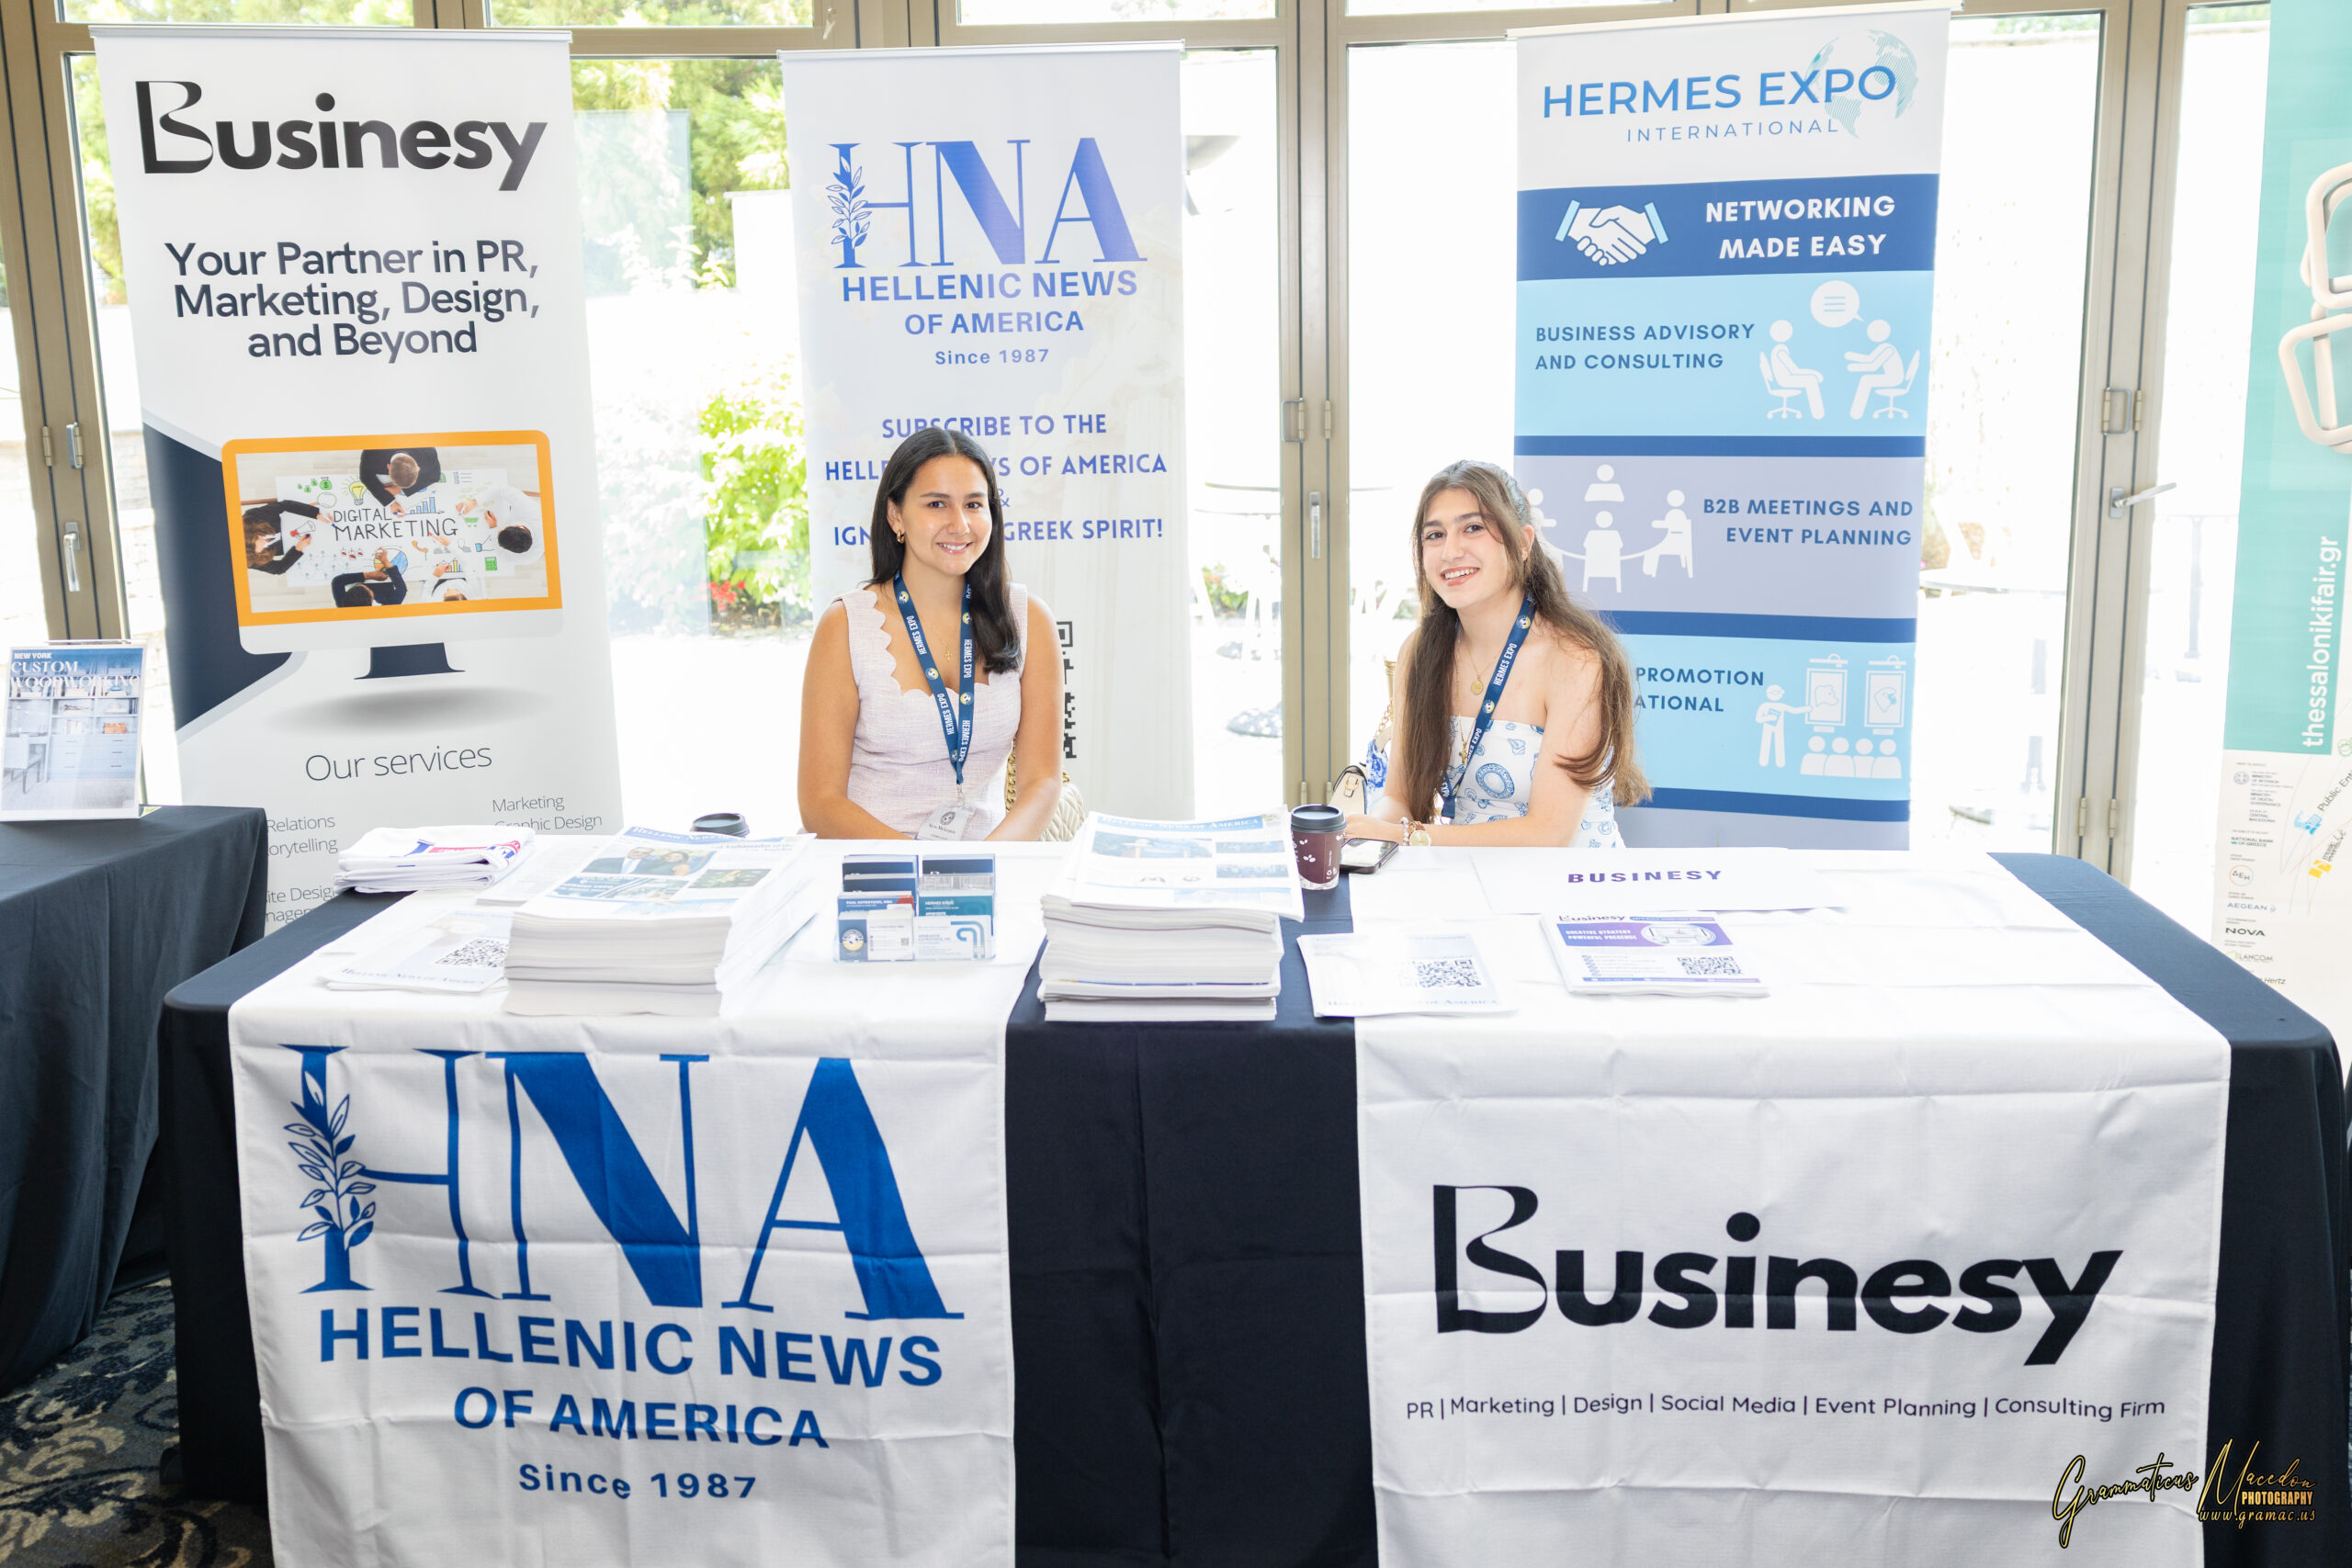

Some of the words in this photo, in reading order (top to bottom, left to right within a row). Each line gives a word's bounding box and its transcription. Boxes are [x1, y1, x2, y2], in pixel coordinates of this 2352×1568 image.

[1544, 74, 1741, 118] HERMES
[1759, 65, 1896, 106] EXPO
[135, 80, 548, 191] Businesy
[1626, 118, 1838, 142] INTERNATIONAL
[826, 138, 1148, 268] HNA
[1706, 196, 1895, 222] NETWORKING
[1719, 238, 1799, 259] MADE
[1811, 234, 1887, 256] EASY
[164, 242, 266, 276] Your
[277, 242, 423, 275] Partner
[433, 240, 466, 273] in
[476, 239, 539, 278] PR,
[842, 273, 1021, 301] HELLENIC
[1034, 270, 1137, 298] NEWS
[175, 283, 390, 324] Marketing,
[401, 281, 539, 322] Design,
[905, 314, 943, 334] OF
[951, 311, 1084, 333] AMERICA
[1536, 325, 1635, 342] BUSINESS
[1644, 323, 1755, 341] ADVISORY
[248, 324, 321, 357] and
[334, 321, 477, 363] Beyond
[935, 350, 990, 365] Since
[1000, 349, 1049, 363] 1987
[1535, 355, 1576, 370] AND
[1585, 353, 1724, 369] CONSULTING
[1020, 416, 1054, 434] TO
[1063, 414, 1106, 434] THE
[1021, 457, 1052, 476] OF
[1062, 454, 1167, 474] AMERICA
[334, 509, 392, 523] DIGITAL
[1703, 499, 1740, 514] B2B
[1747, 499, 1860, 516] MEETINGS
[1869, 501, 1914, 516] AND
[334, 518, 458, 541] MARKETING
[1005, 521, 1072, 540] GREEK
[1082, 519, 1163, 538] SPIRIT!
[1726, 527, 1793, 543] EVENT
[1801, 528, 1912, 546] PLANNING
[907, 615, 918, 629] EXPO
[912, 631, 927, 655] HERMES
[964, 639, 972, 662] HERMES
[2301, 536, 2341, 748] thessalonikifair.gr
[11, 661, 78, 672] CUSTOM
[964, 664, 972, 678] EXPO
[1493, 659, 1510, 686] HERMES
[1503, 643, 1518, 660] EXPO
[1636, 668, 1763, 685] PROMOTION
[937, 694, 949, 707] EXPO
[943, 708, 955, 735] HERMES
[961, 720, 970, 745] HERMES
[305, 754, 365, 781] Our
[374, 746, 492, 776] services
[958, 746, 967, 761] EXPO
[492, 795, 564, 812] Marketing
[554, 814, 602, 831] Design
[1567, 870, 1722, 884] BUSINESY
[2225, 928, 2266, 936] NOVA
[279, 1043, 965, 1321] HNA
[1432, 1184, 2124, 1367] Businesy
[321, 1306, 694, 1377] HELLENIC
[718, 1325, 943, 1388] NEWS
[454, 1386, 534, 1430] OF
[548, 1393, 830, 1450] AMERICA
[1406, 1402, 1433, 1420] PR
[1451, 1394, 1555, 1418] Marketing
[1573, 1393, 1643, 1417] Design
[1661, 1393, 1725, 1413] Social
[1732, 1394, 1796, 1415] Media
[1815, 1397, 1876, 1416] Event
[1883, 1396, 1976, 1419] Planning
[1995, 1396, 2113, 1423] Consulting
[2120, 1399, 2165, 1417] Firm
[518, 1463, 632, 1500] Since
[650, 1472, 756, 1500] 1987
